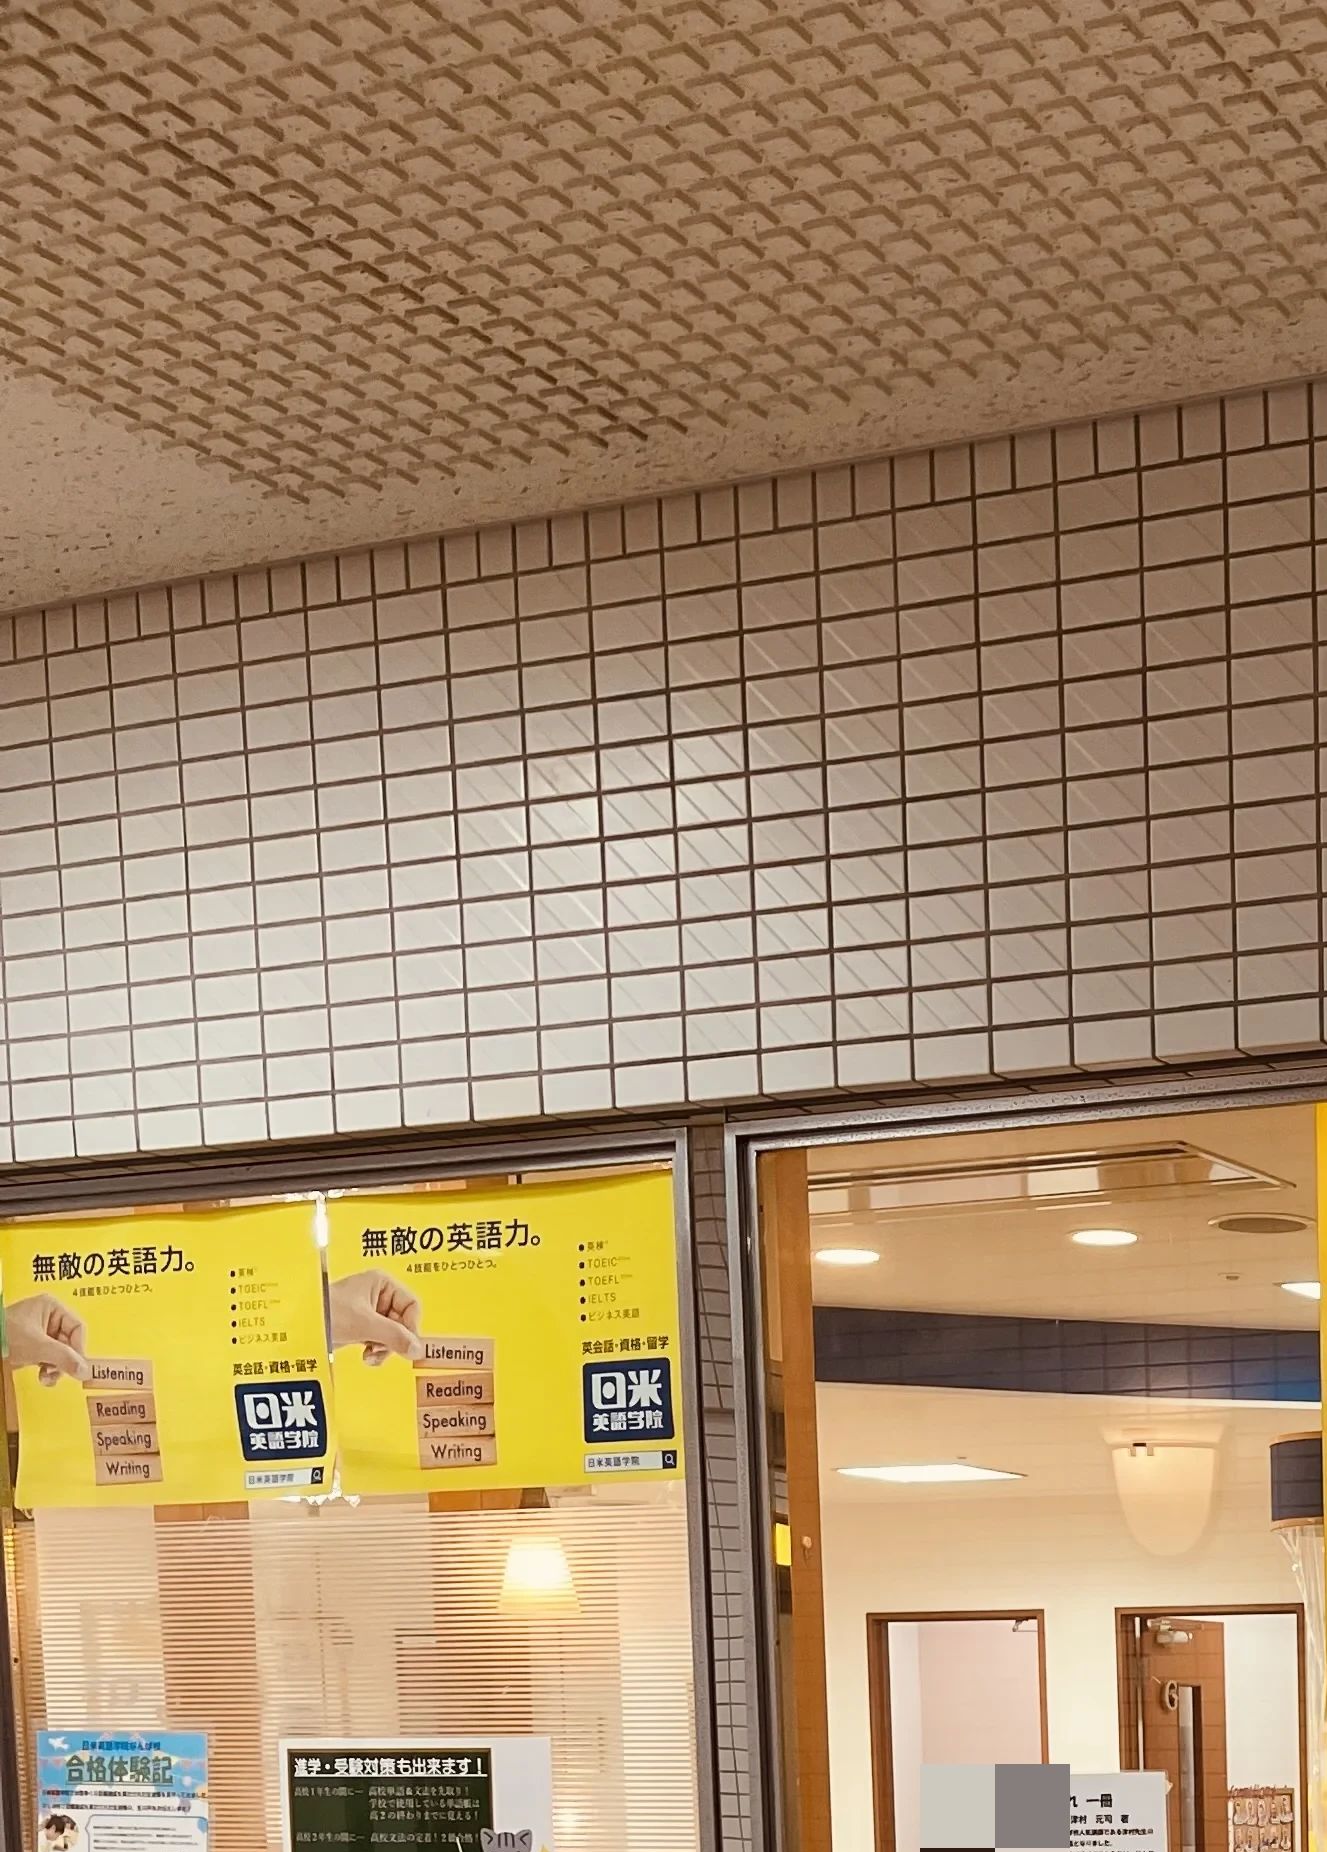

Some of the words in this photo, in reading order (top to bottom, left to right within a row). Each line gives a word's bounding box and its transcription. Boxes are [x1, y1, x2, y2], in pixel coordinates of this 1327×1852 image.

[361, 1218, 541, 1257] 無敵の英語力。
[32, 1245, 195, 1282] 無敵の英語力。
[425, 1344, 484, 1365] Listening
[91, 1364, 144, 1386] Listening
[426, 1381, 483, 1400] Reading
[591, 1368, 663, 1410] 日米
[96, 1401, 146, 1419] Reading
[243, 1391, 318, 1430] 日米
[422, 1412, 487, 1431] Speaking
[592, 1409, 664, 1433] 英語学院
[96, 1429, 152, 1450] Speaking
[249, 1430, 319, 1451] 英語学院
[431, 1444, 482, 1462] Writing
[106, 1460, 151, 1479] Writing
[65, 1755, 173, 1785] 合格体験記
